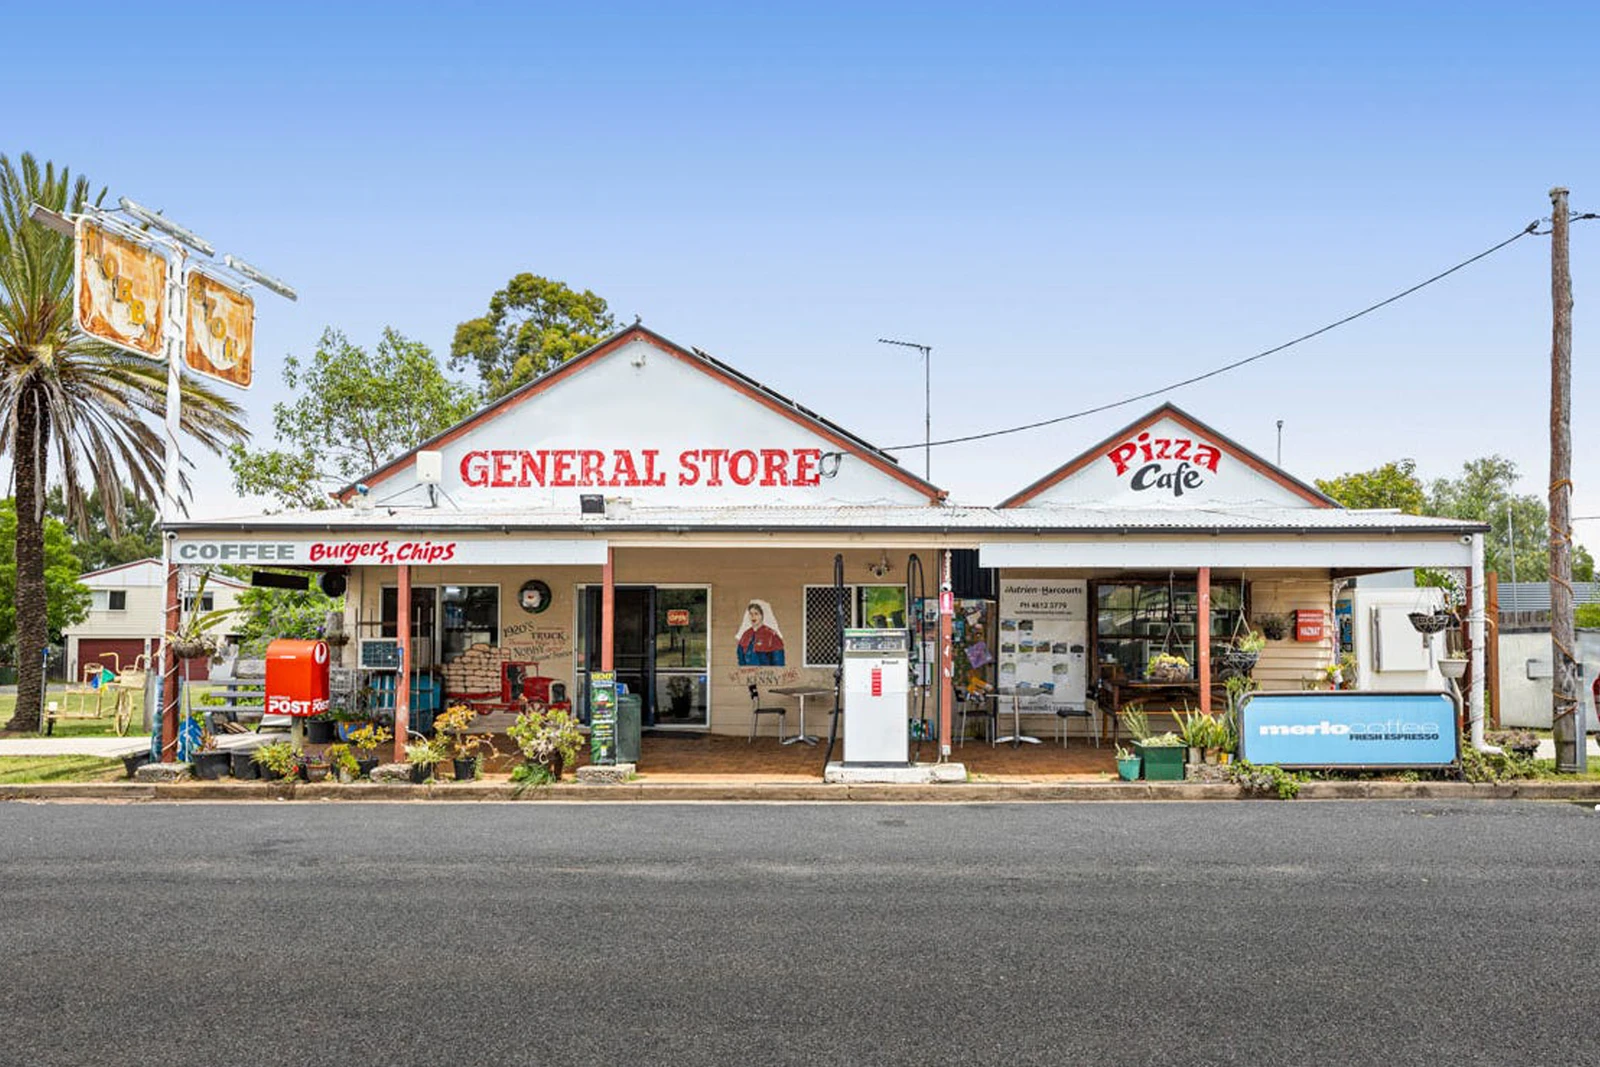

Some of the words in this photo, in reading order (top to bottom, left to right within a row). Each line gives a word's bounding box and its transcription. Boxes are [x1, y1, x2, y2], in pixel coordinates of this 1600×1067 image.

[1107, 432, 1221, 476] Pizza
[460, 449, 666, 487] GENERAL
[679, 449, 821, 487] STORE
[1131, 462, 1203, 497] Cafe
[180, 544, 294, 560] COFFEE
[309, 541, 389, 564] Burgers
[396, 542, 456, 563] Chips
[1042, 586, 1082, 595] Harcourts
[531, 632, 567, 641] TRUCK
[269, 701, 311, 714] POST
[1350, 733, 1383, 741] FRESH
[1384, 733, 1440, 741] ESPRESSO
